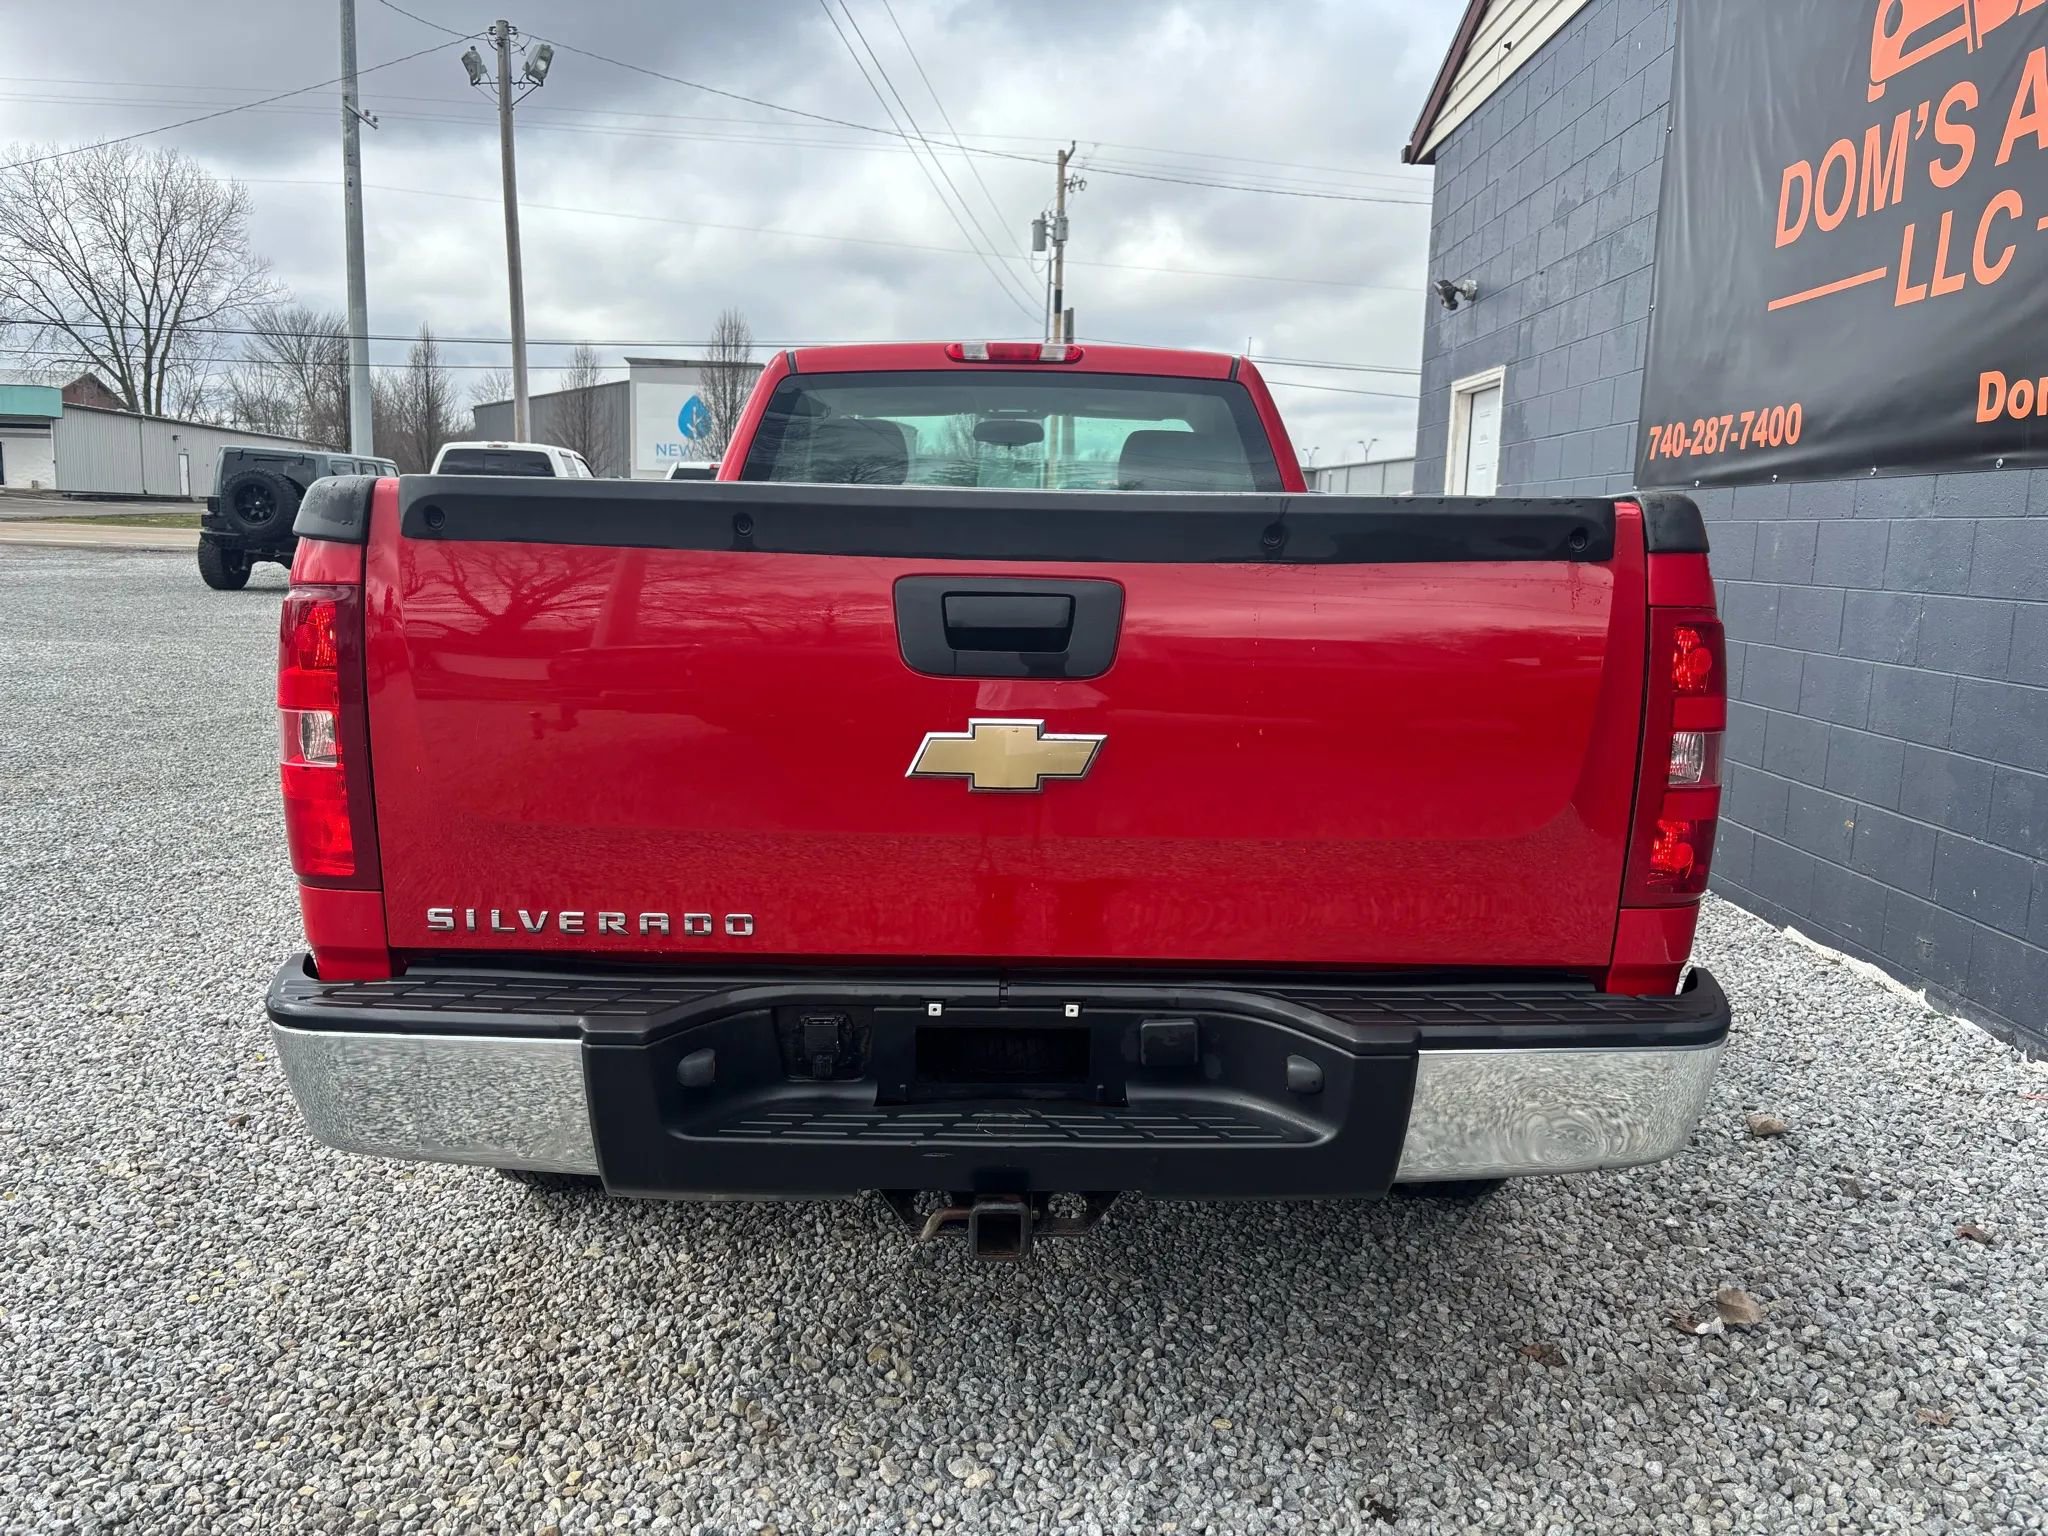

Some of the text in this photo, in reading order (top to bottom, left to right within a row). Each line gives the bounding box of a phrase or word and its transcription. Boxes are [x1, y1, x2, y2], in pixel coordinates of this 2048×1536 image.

[1775, 81, 1979, 249] DOM'S
[1894, 189, 2023, 307] LLC
[1649, 403, 1802, 460] 740-287-7400
[427, 907, 754, 937] SILVERADO
